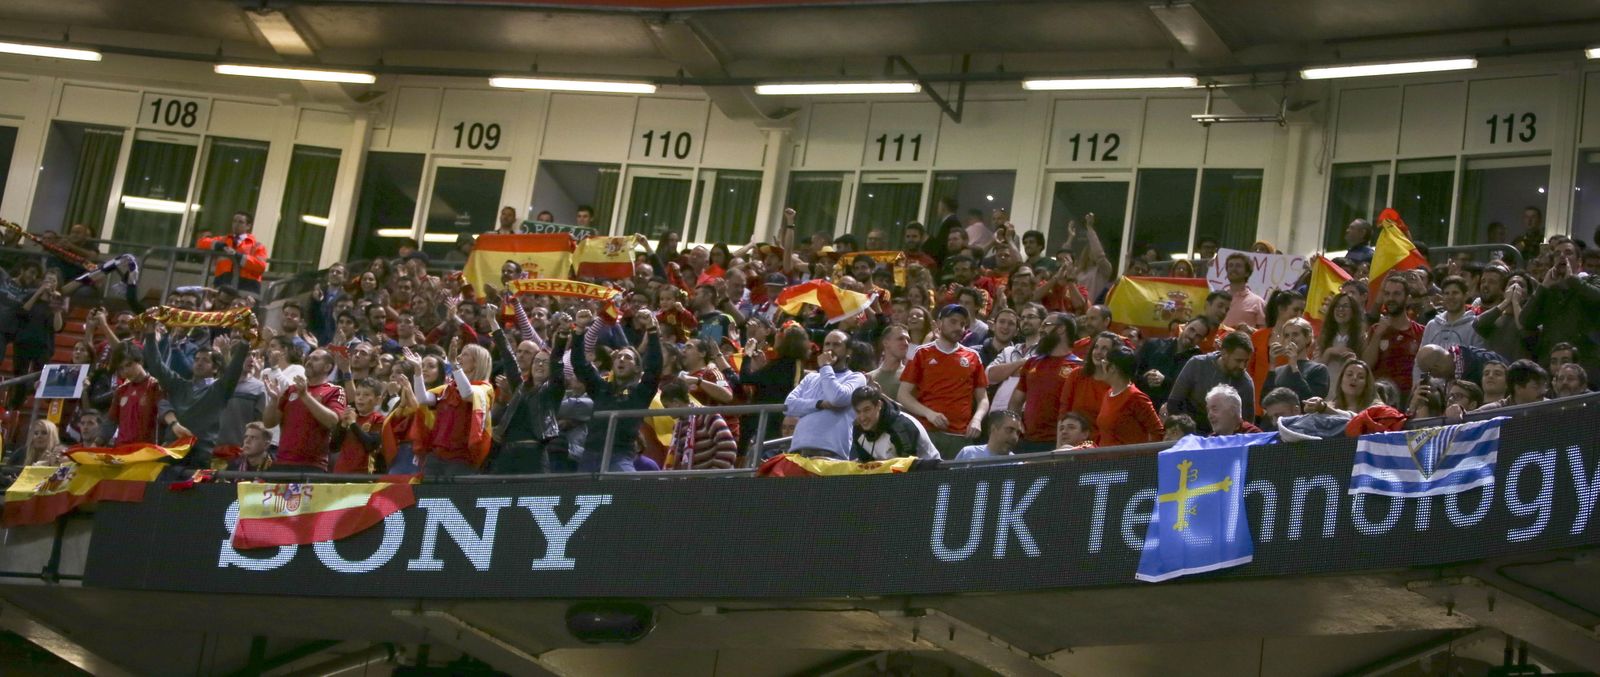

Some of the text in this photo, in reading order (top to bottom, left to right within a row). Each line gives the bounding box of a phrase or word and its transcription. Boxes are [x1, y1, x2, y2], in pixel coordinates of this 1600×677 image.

[151, 98, 198, 128] 108
[1485, 112, 1537, 144] 113
[453, 121, 501, 151] 109
[642, 130, 692, 160] 110
[876, 133, 922, 162] 111
[1069, 133, 1121, 162] 112
[1215, 255, 1303, 288] VMOS
[930, 476, 1050, 562] UK
